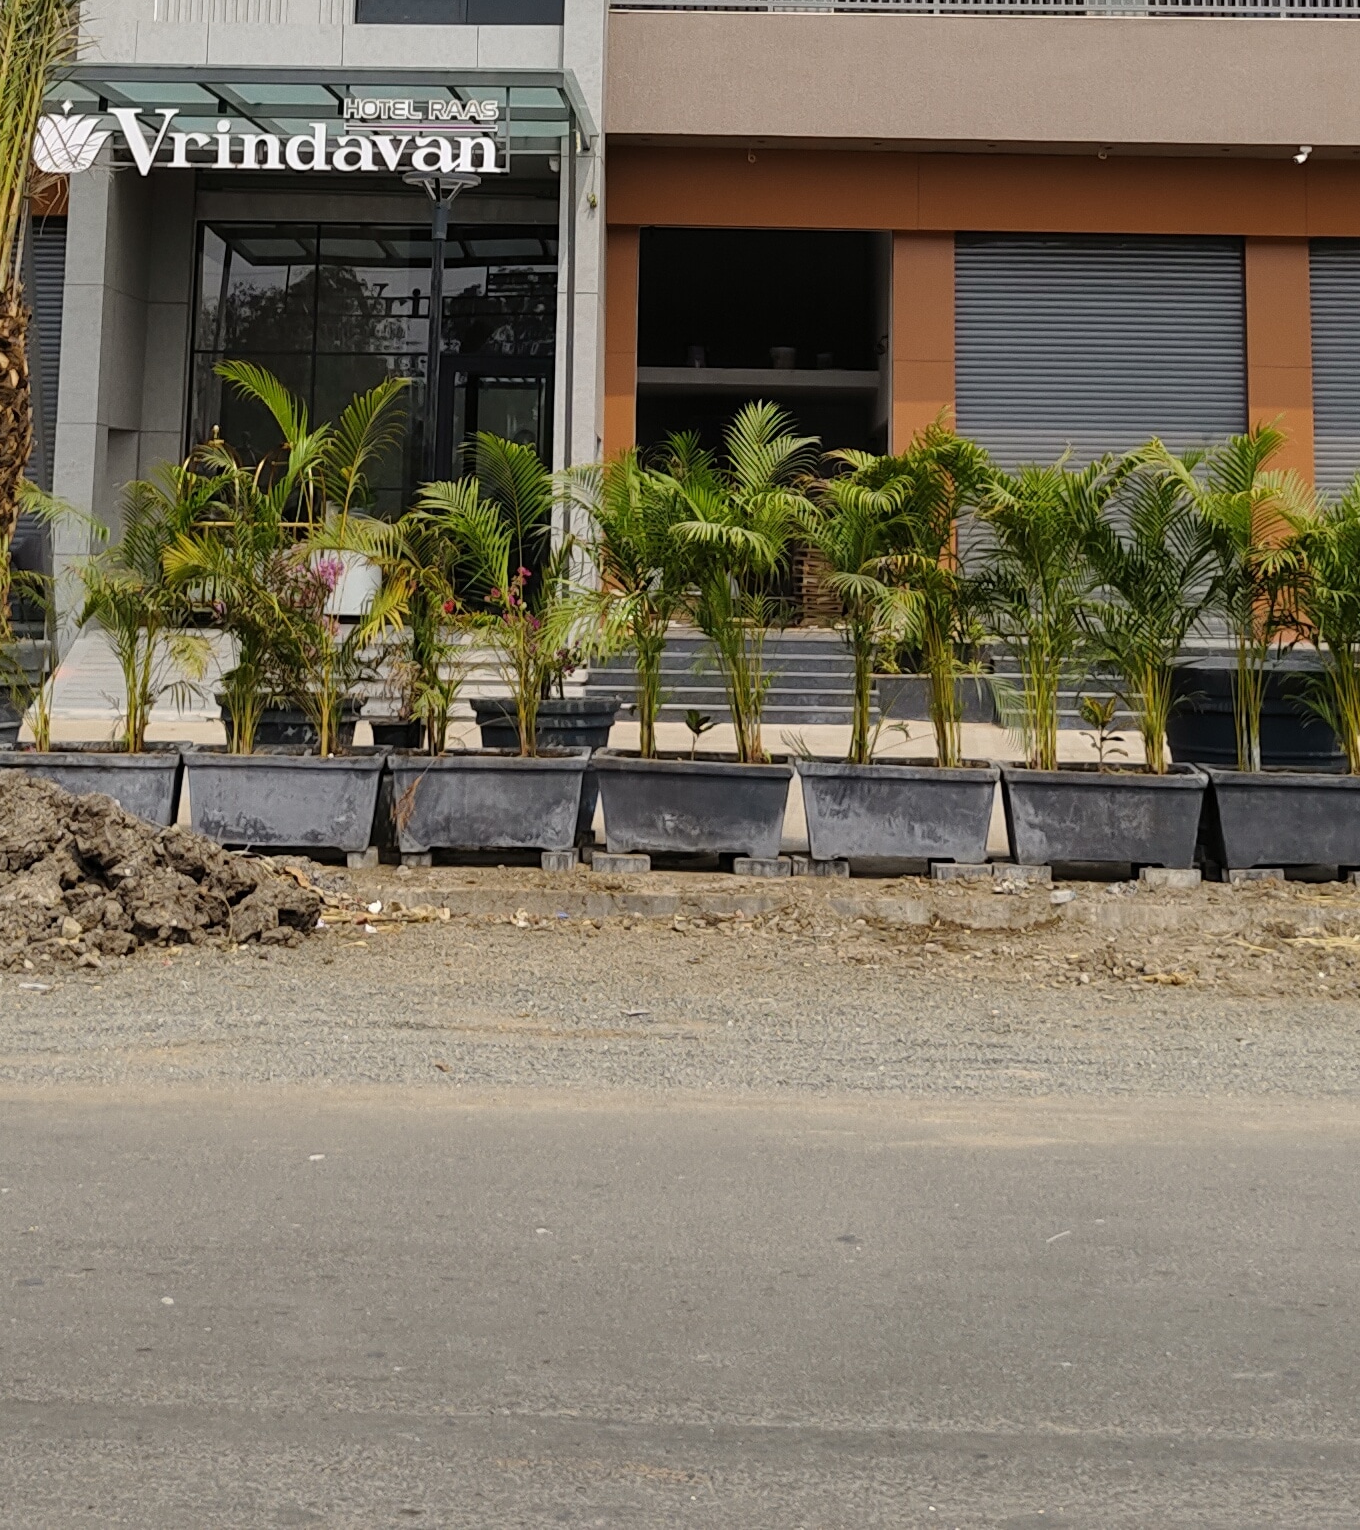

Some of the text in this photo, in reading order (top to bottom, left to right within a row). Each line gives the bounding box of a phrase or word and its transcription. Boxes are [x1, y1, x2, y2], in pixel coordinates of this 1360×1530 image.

[343, 98, 499, 120] HOTEL RAAS
[108, 107, 507, 176] Vrindavan
